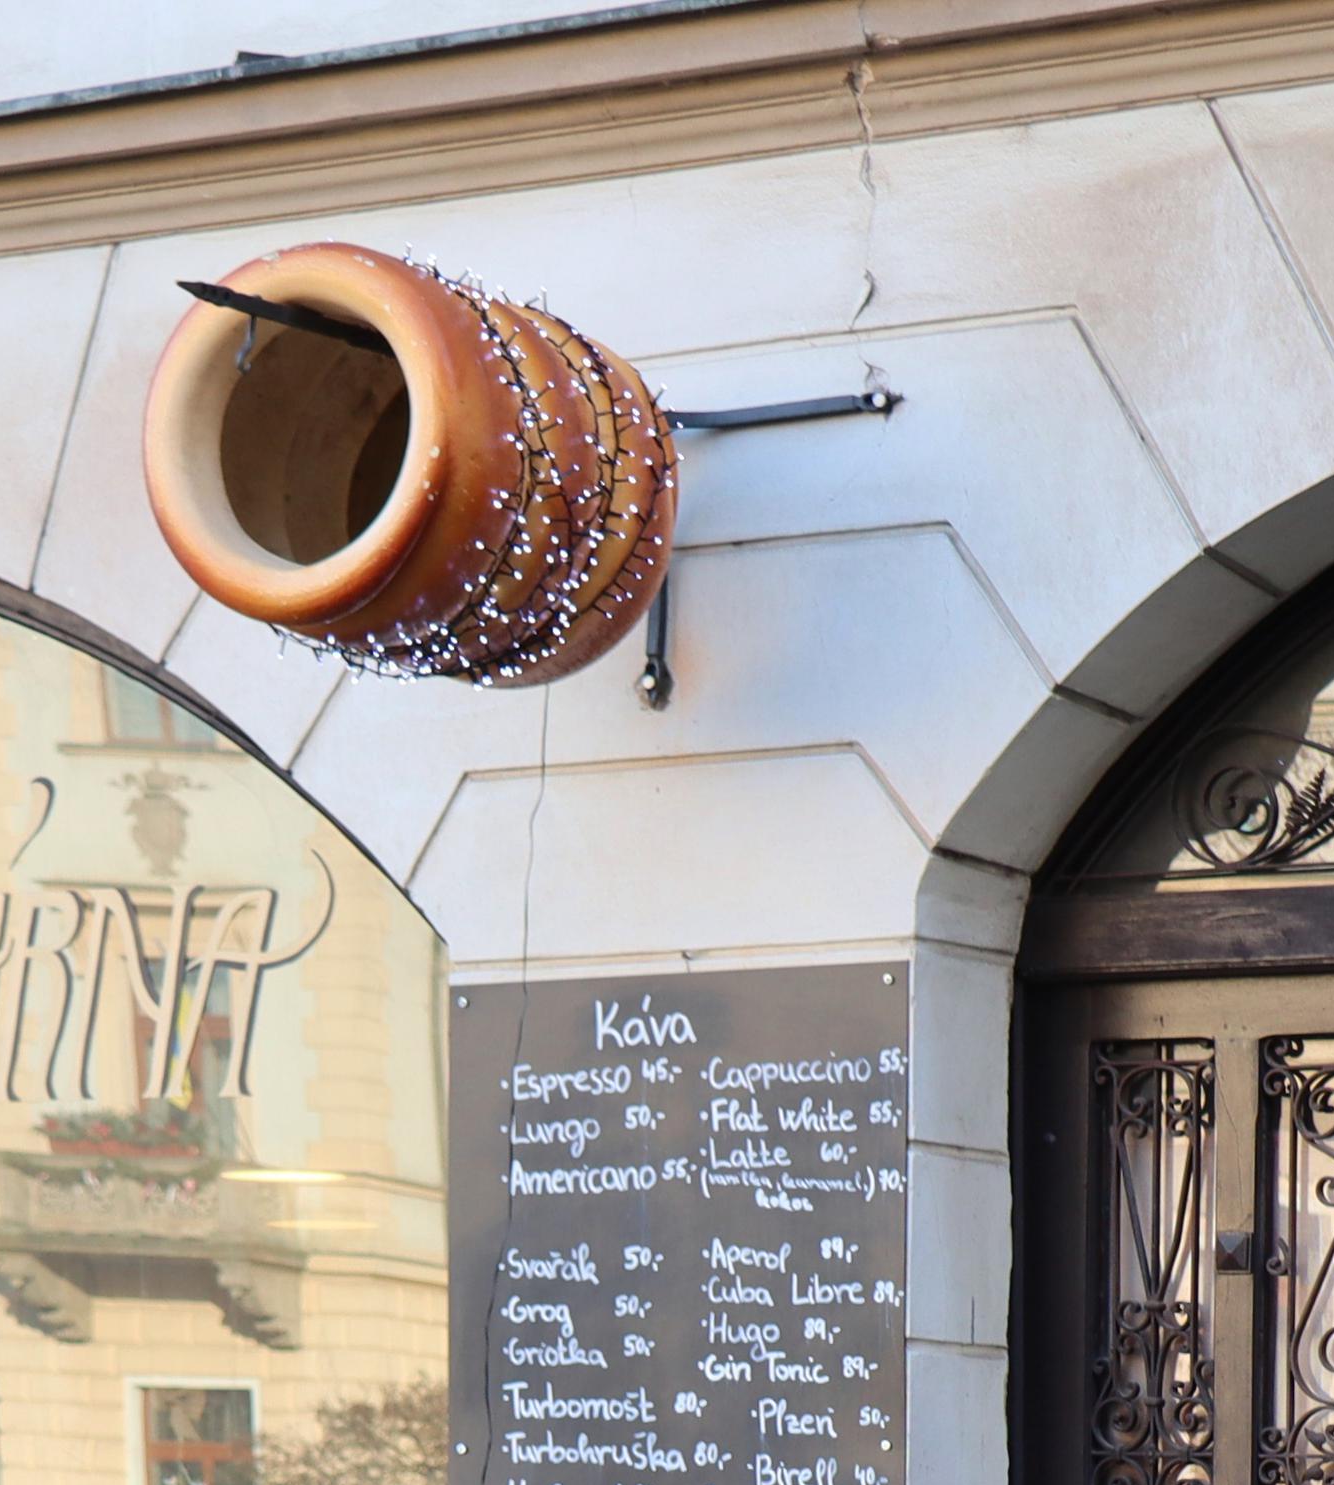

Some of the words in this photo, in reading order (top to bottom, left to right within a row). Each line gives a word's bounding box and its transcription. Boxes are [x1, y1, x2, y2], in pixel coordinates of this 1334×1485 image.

[595, 995, 697, 1051] Káva
[512, 1064, 631, 1103] Espresso
[708, 1051, 872, 1094] Cappuccino
[710, 1097, 769, 1132] Flat
[510, 1114, 601, 1158] Lungo
[709, 1136, 792, 1170] Latte
[510, 1160, 658, 1196] Americano
[507, 1241, 600, 1286] Svařák
[710, 1237, 792, 1275] Aperol
[707, 1273, 774, 1307] Cuba
[791, 1272, 865, 1306] Libre
[506, 1297, 574, 1337] Grog
[507, 1337, 608, 1368] Griotka
[708, 1312, 780, 1362] Hugo
[704, 1354, 751, 1383] Gin
[766, 1351, 830, 1384] Tonic
[503, 1381, 657, 1423] Turbomošt
[505, 1430, 687, 1472] Turbohruška
